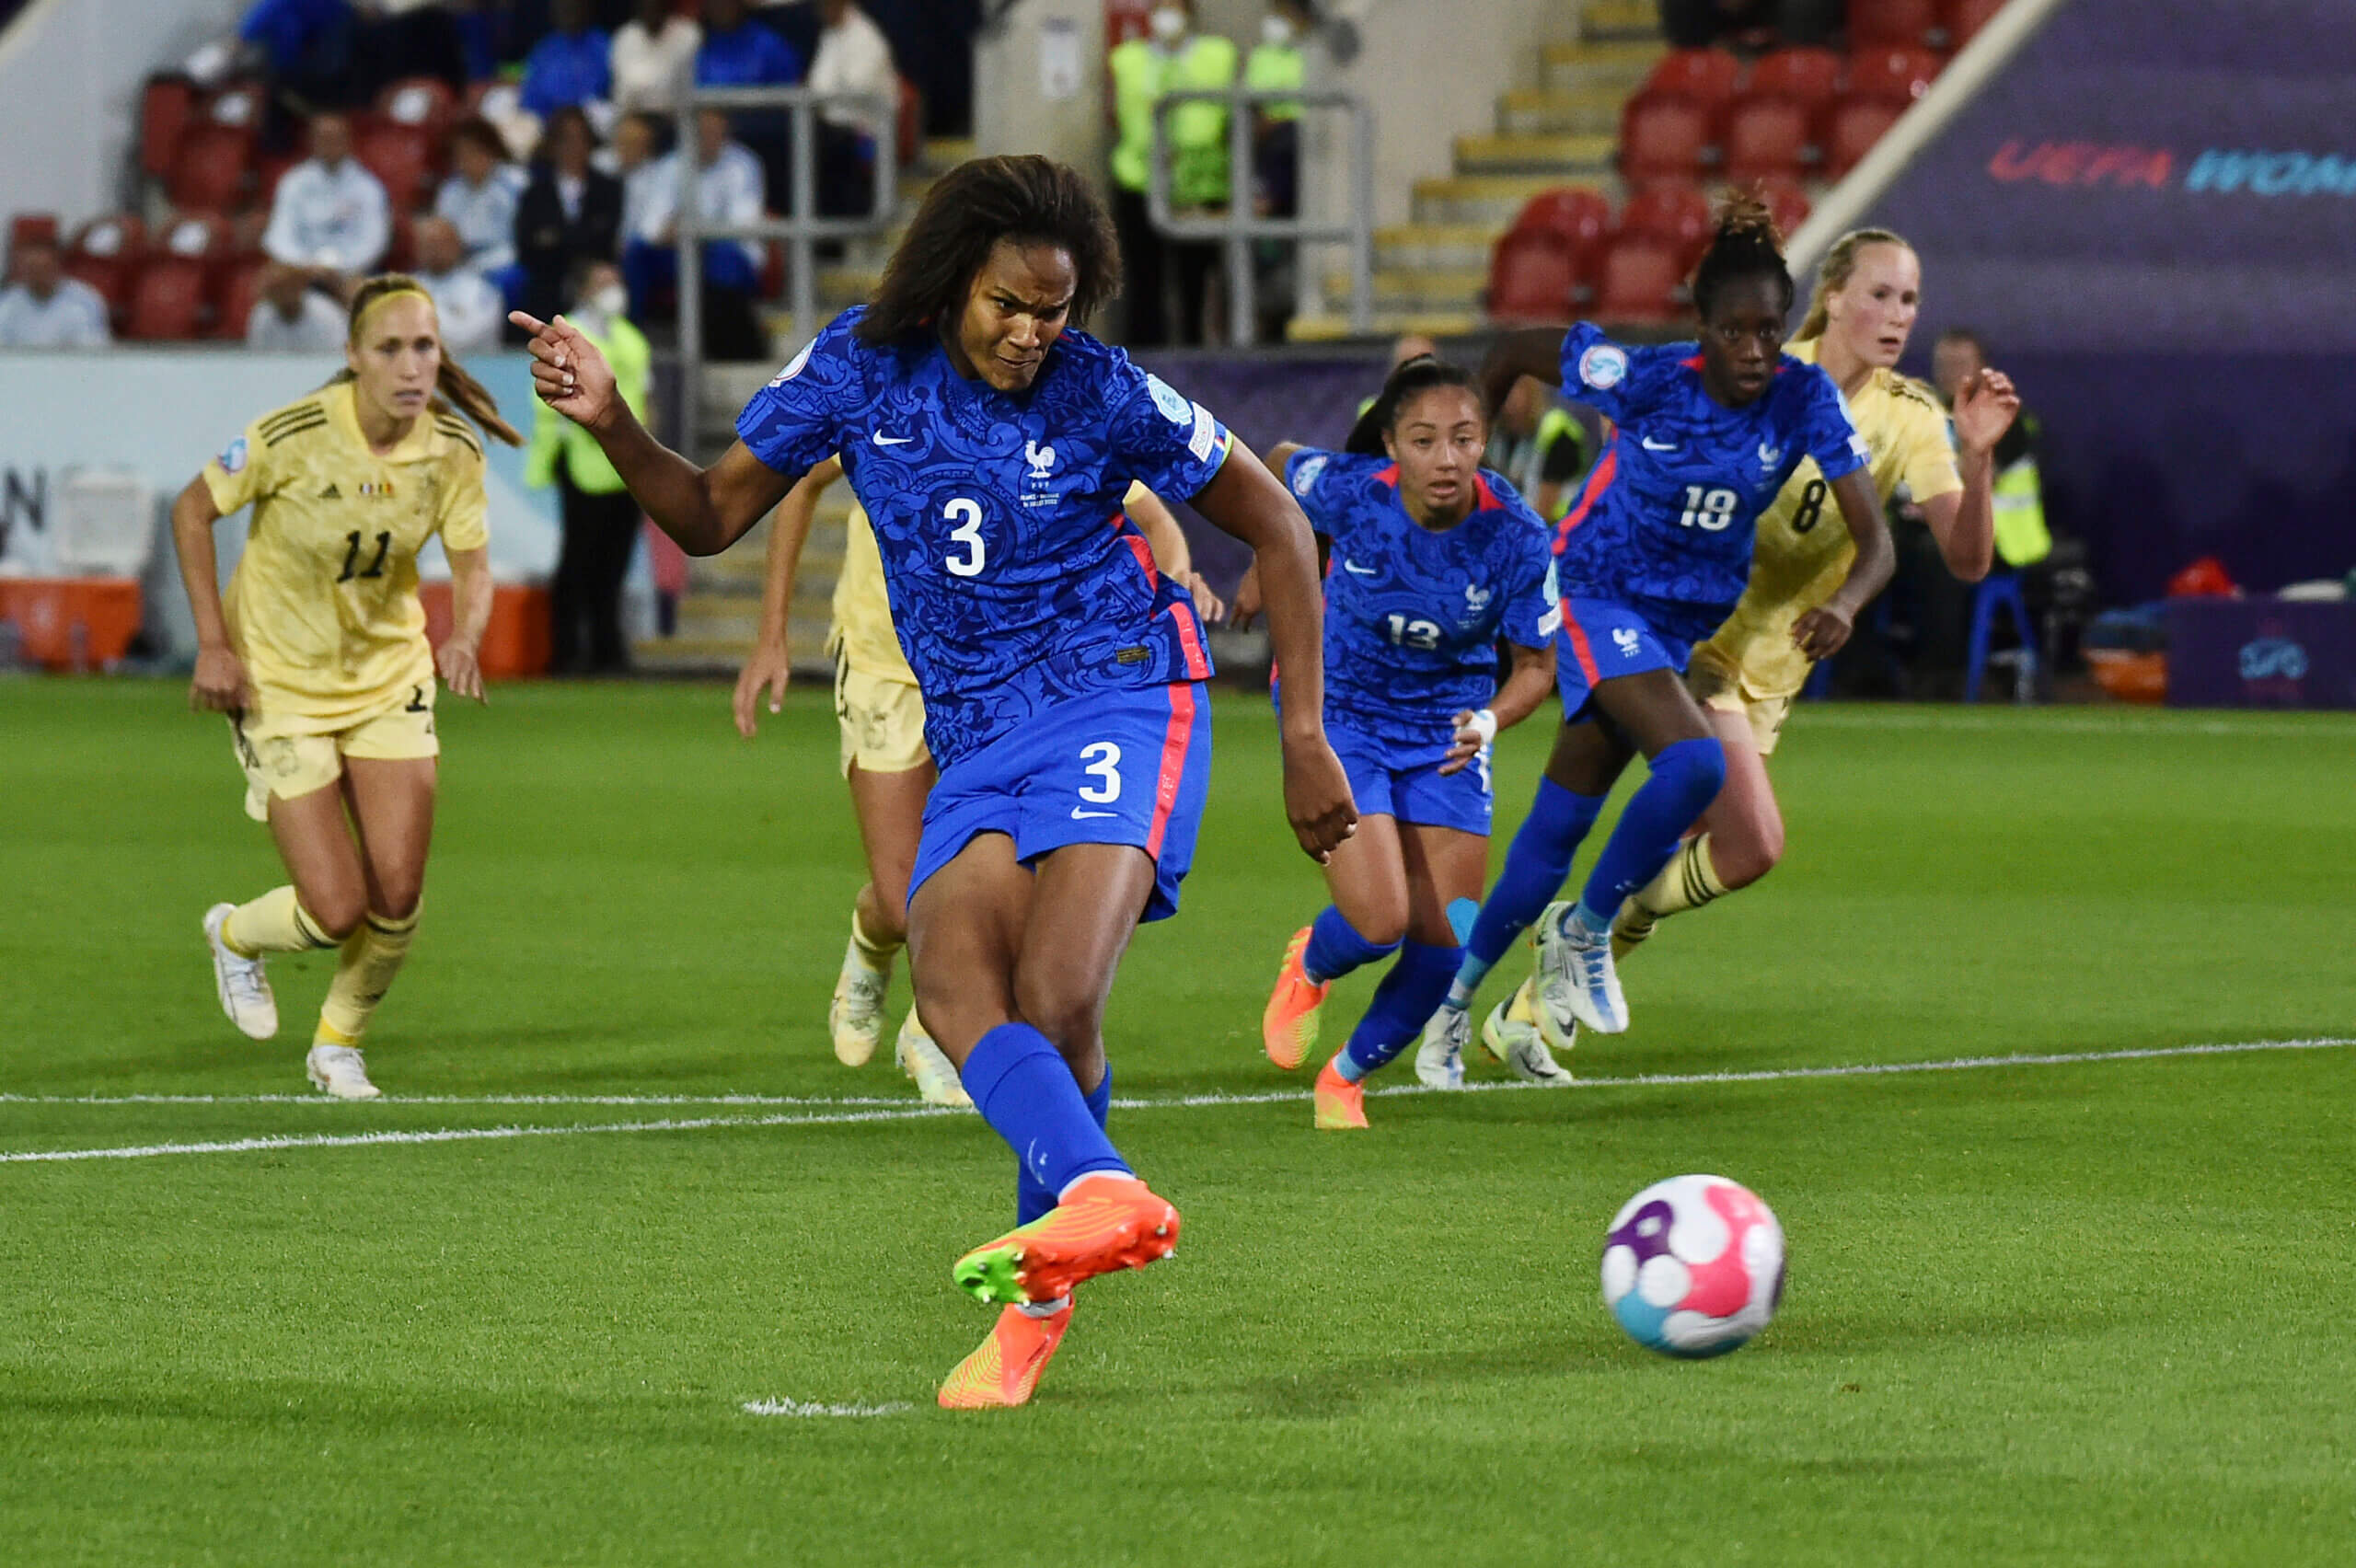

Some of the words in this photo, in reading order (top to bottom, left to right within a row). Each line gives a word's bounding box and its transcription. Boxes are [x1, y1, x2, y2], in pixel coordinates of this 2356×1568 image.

[1990, 141, 2173, 187] UEFA
[1792, 478, 1826, 534] 8
[337, 529, 391, 583] 11
[943, 498, 986, 576] 3
[1388, 614, 1440, 650] 13
[1078, 742, 1121, 803] 3
